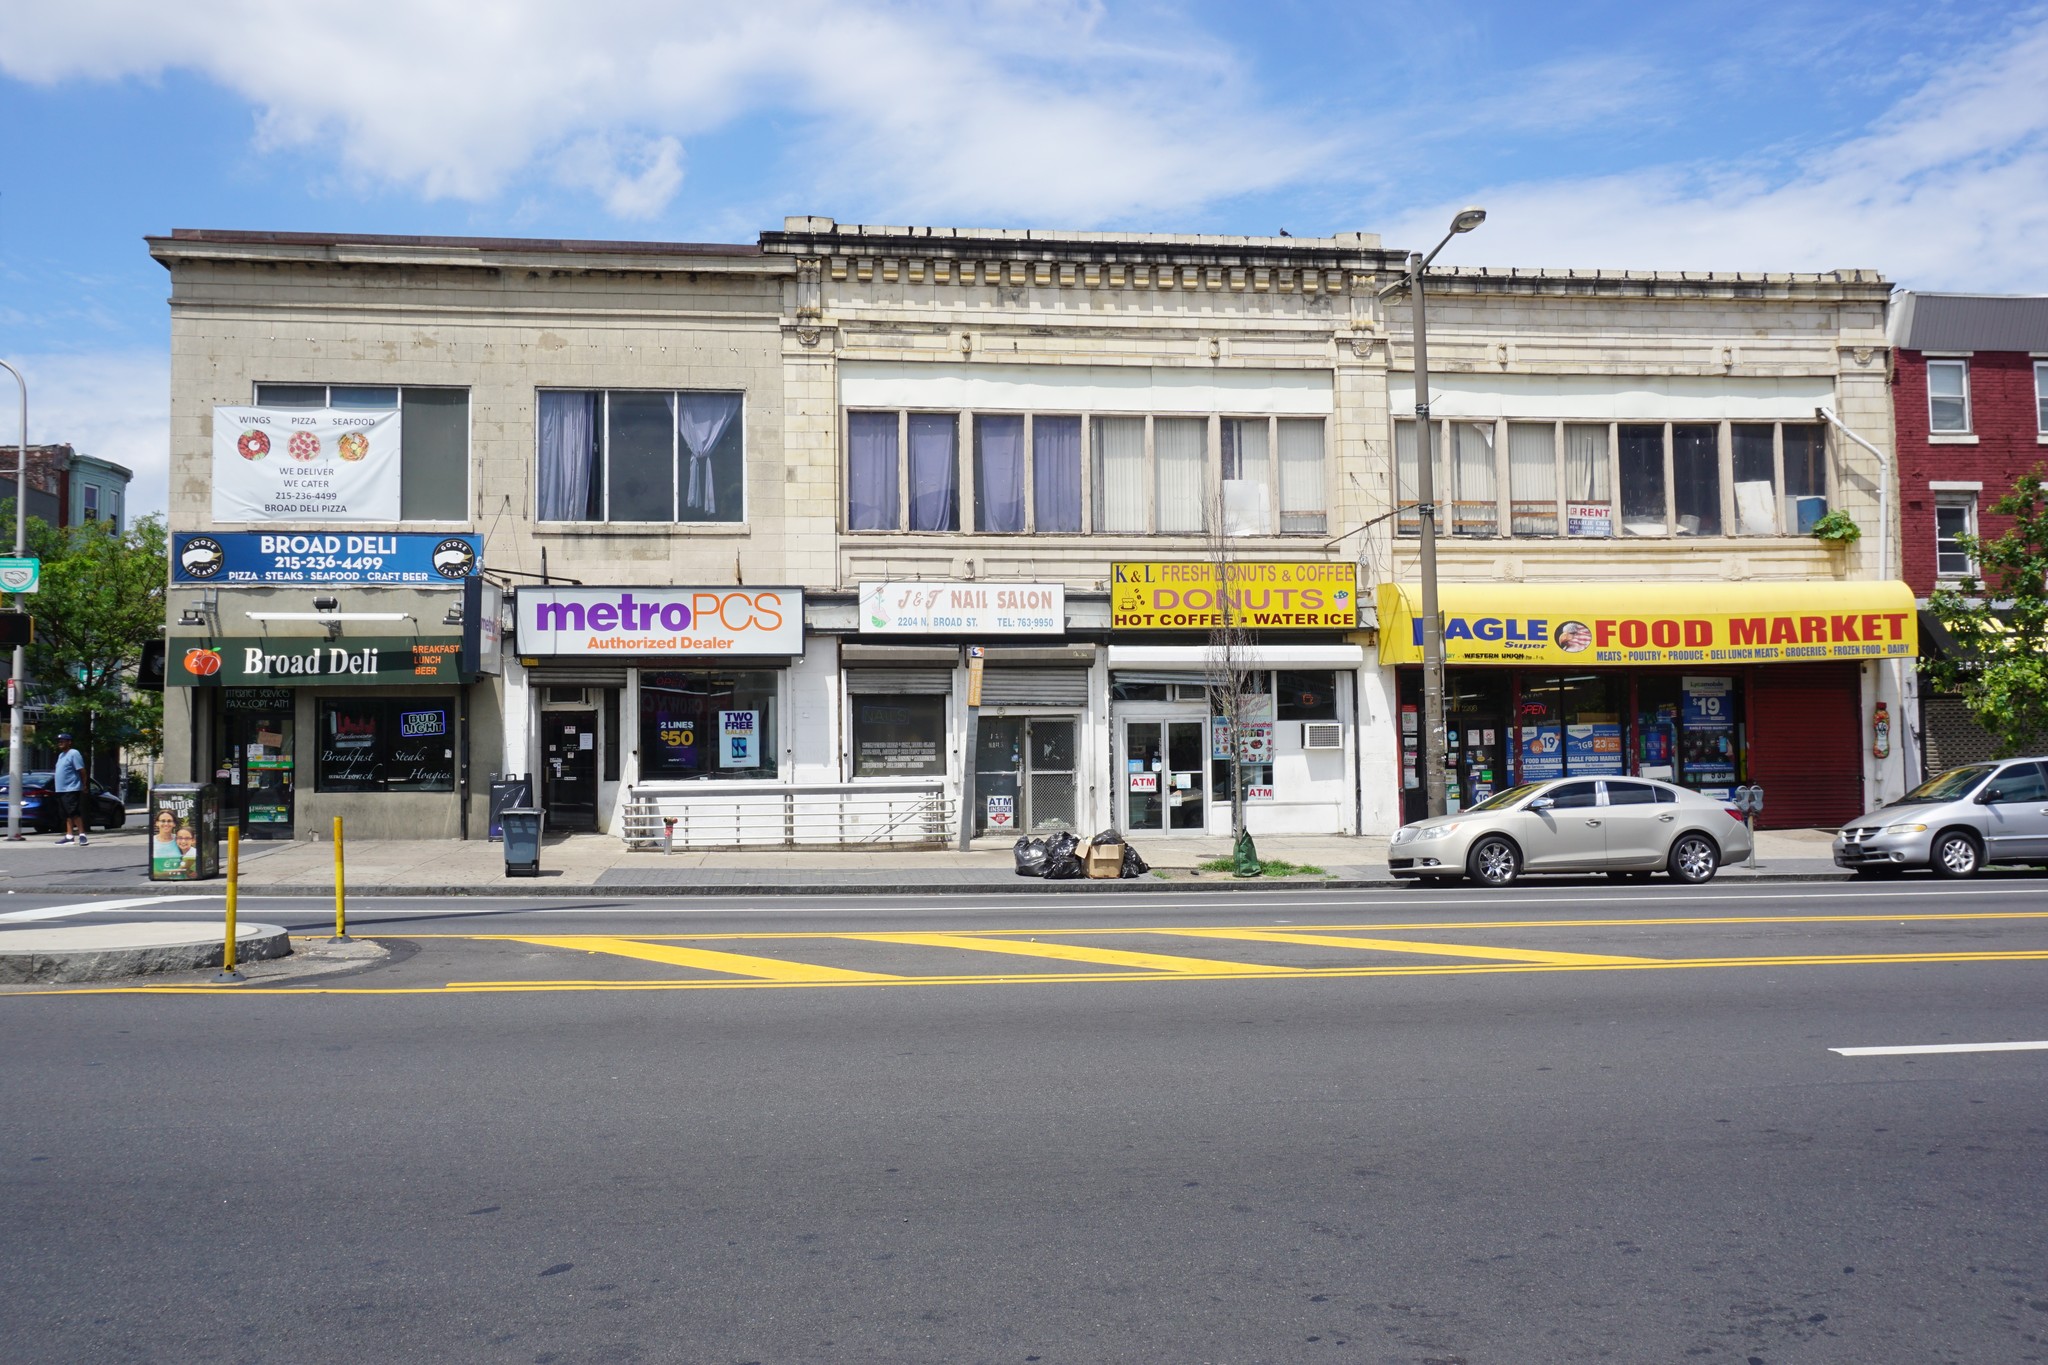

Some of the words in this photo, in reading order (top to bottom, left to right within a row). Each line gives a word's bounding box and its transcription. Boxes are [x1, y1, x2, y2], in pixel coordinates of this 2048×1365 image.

[239, 415, 271, 425] WINGS
[291, 417, 317, 425] PIZZA
[332, 418, 375, 426] SEAFOOD
[279, 467, 294, 476] WE
[297, 467, 334, 476] DELIVER
[283, 479, 298, 488] WE
[301, 480, 329, 488] CATER
[275, 491, 337, 500] 215-236-4499
[264, 504, 297, 512] BROAD
[300, 504, 319, 513] DELI
[321, 504, 347, 513] PIZZA
[1580, 508, 1610, 518] RENT
[188, 540, 216, 550] GOOSE
[261, 535, 341, 554] BROAD
[347, 536, 397, 554] DELI
[440, 542, 467, 551] GOOSE
[275, 555, 383, 570] 215-236-4499
[188, 564, 217, 576] ISLAND
[438, 565, 469, 577] ISLAND
[1115, 565, 1128, 583] K
[1130, 571, 1141, 583] &
[1145, 565, 1155, 583] L
[1161, 565, 1210, 582] FRESH
[1215, 565, 1276, 582] DONUTS
[1281, 569, 1292, 581] &
[1296, 565, 1354, 582] COFFEE
[228, 571, 258, 580] PIZZA
[265, 571, 304, 580] STEAKS
[310, 572, 360, 581] SEAFOOD
[367, 572, 400, 581] CRAFT
[402, 572, 428, 581] BEER
[897, 590, 912, 609] J
[913, 592, 924, 605] &
[951, 590, 988, 609] NAIL
[997, 590, 1053, 610] SALON
[1153, 589, 1325, 610] DONUTS
[536, 592, 783, 632] metroPCS
[897, 617, 918, 627] 2204
[920, 617, 930, 627] N.
[933, 617, 963, 627] BROAD
[966, 617, 978, 627] ST.
[997, 618, 1015, 627] TEL:
[1114, 614, 1155, 625] HOT
[1160, 614, 1233, 625] COFFEE
[1254, 613, 1319, 625] WATER
[1324, 613, 1354, 625] ICE
[1595, 619, 1713, 648] FOOD
[1728, 613, 1909, 646] MARKET
[587, 636, 676, 649] Authorized
[680, 636, 734, 649] Dealer
[1503, 641, 1548, 650] Super
[412, 645, 460, 653] BREAKFAST
[1596, 651, 1622, 661] MEATS
[1628, 650, 1661, 661] POULTRY
[1668, 650, 1704, 661] PRODUCE
[1710, 649, 1727, 660] DELI
[1728, 649, 1753, 659] LUNCH
[1755, 648, 1779, 658] MEATS
[1785, 646, 1827, 657] GROCERIES
[1833, 645, 1861, 656] FROZEN
[1861, 644, 1881, 655] FOOD
[1887, 644, 1909, 654] DAIRY
[243, 647, 320, 674] Broad
[328, 647, 378, 674] Deli
[414, 656, 441, 664] LUNCH
[415, 667, 437, 675] BEER
[226, 700, 241, 708] FAX
[248, 700, 267, 708] COPY
[273, 700, 289, 708] ATM
[1692, 698, 1720, 715] $19
[1522, 704, 1547, 715] OPEN
[408, 713, 437, 724] BUD
[725, 712, 753, 721] TWO
[404, 722, 443, 735] LIGHT
[660, 721, 667, 729] 2
[668, 721, 694, 729] LINES
[725, 721, 753, 730] FREE
[660, 730, 694, 746] $50
[1543, 737, 1556, 749] 19
[1595, 740, 1606, 748] 23
[392, 747, 427, 762] Steaks
[321, 747, 375, 774] Breakfast
[344, 763, 383, 780] Lunch
[409, 767, 450, 790] Hoagies
[1131, 778, 1155, 787] ATM
[1249, 788, 1272, 797] ATM
[159, 799, 194, 810] UNLITTER
[989, 798, 1012, 806] ATM
[177, 809, 189, 818] US
